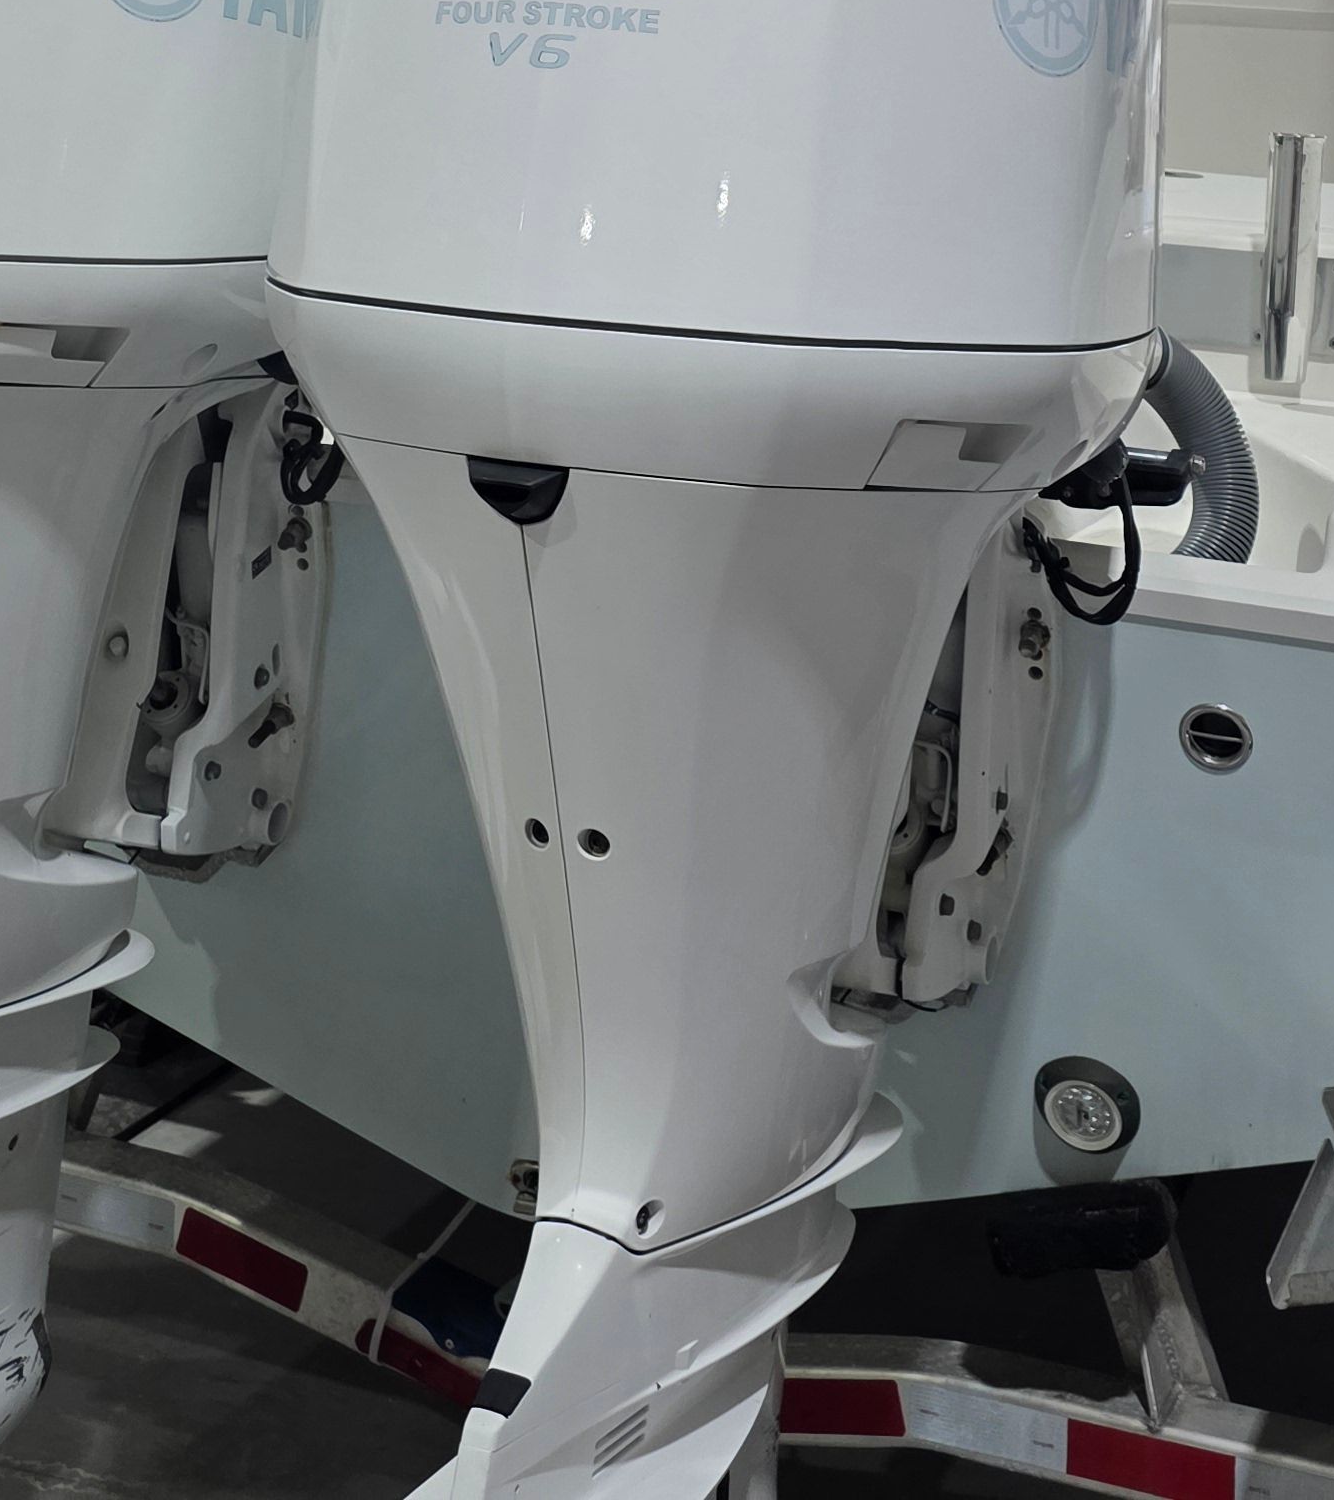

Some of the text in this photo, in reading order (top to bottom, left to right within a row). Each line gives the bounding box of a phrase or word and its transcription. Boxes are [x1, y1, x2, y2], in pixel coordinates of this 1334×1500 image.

[435, 0, 661, 34] FOUR STROKE
[489, 31, 577, 69] V6
